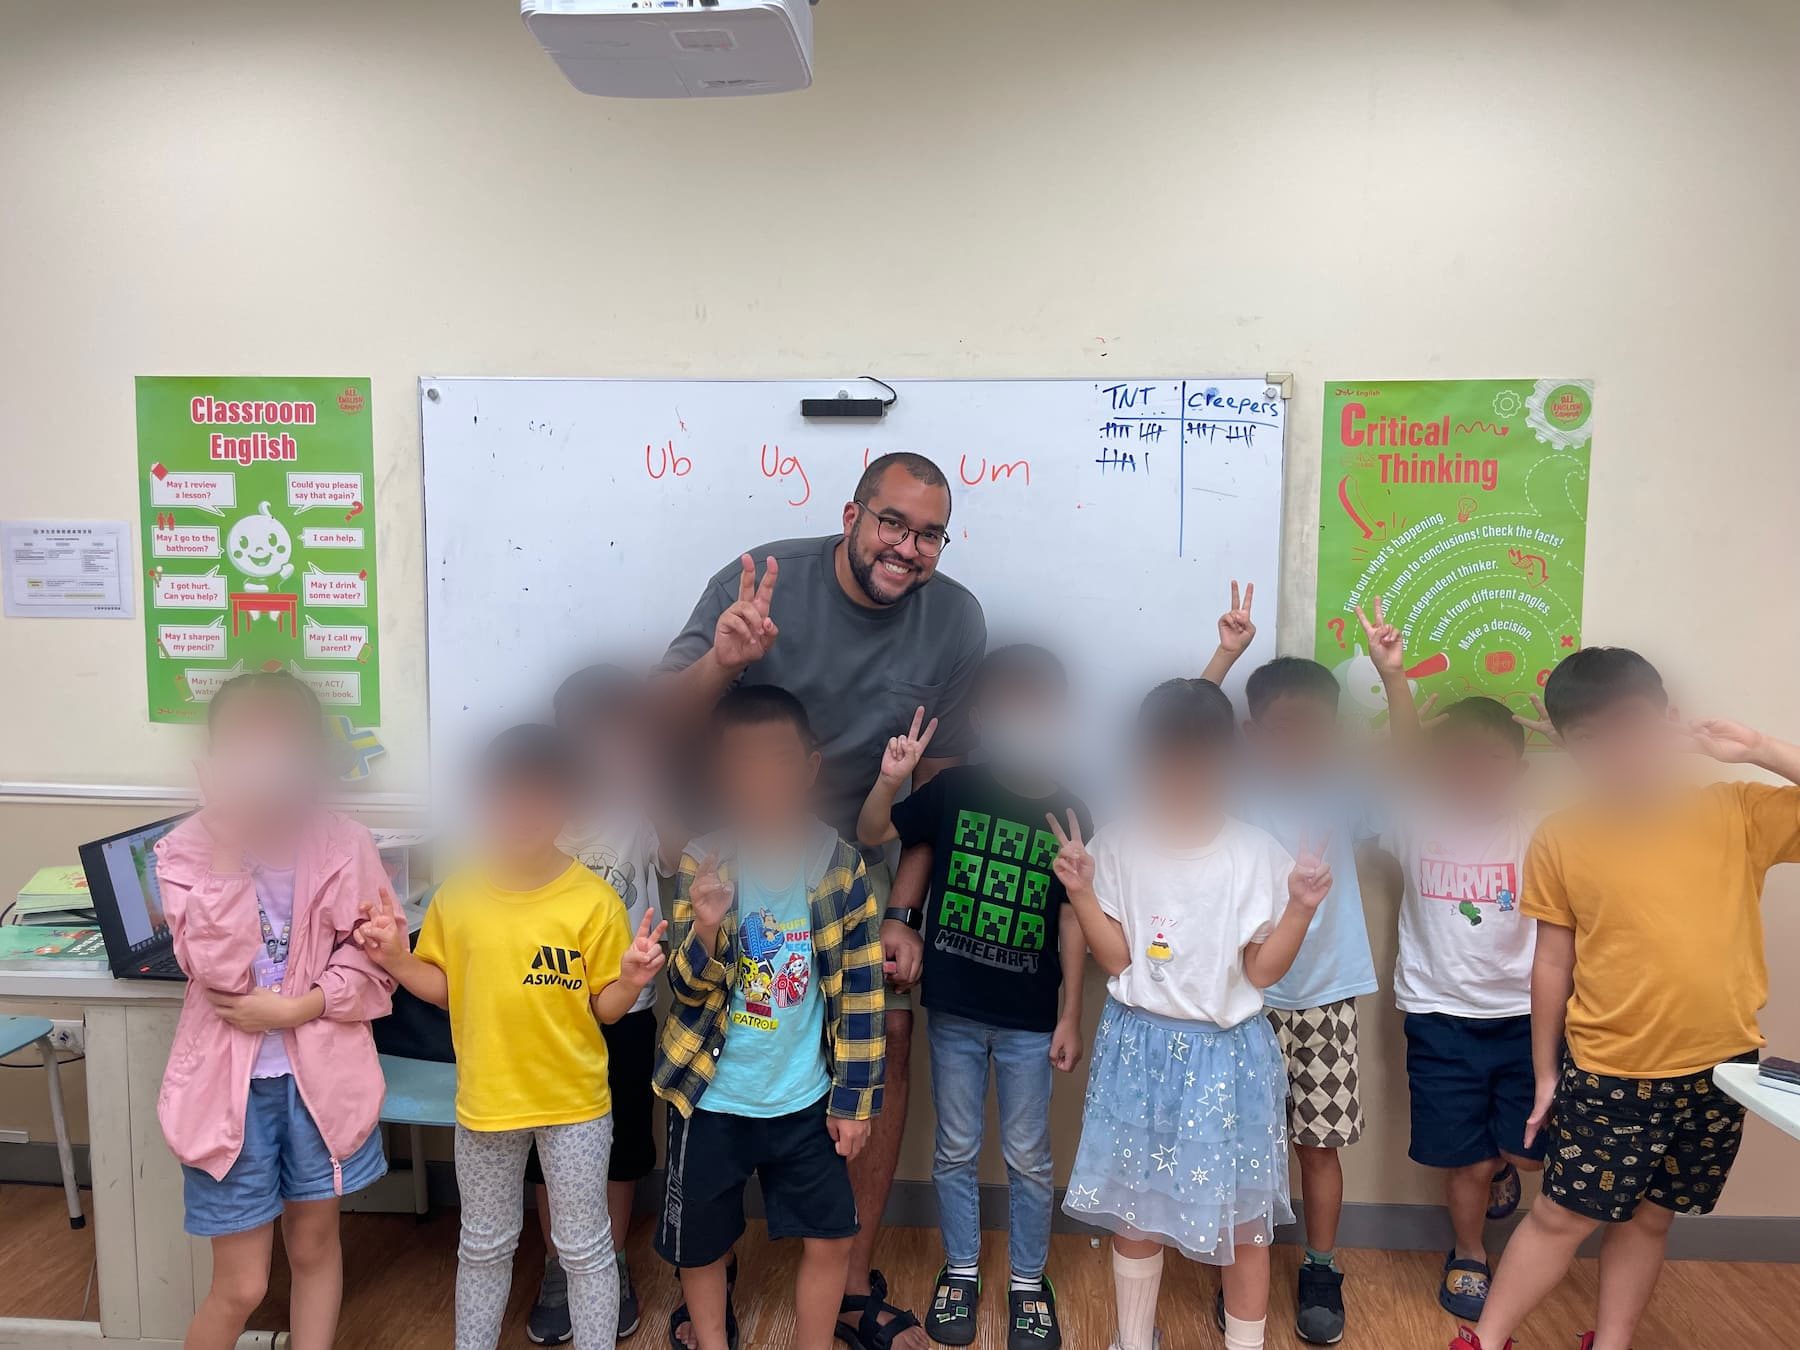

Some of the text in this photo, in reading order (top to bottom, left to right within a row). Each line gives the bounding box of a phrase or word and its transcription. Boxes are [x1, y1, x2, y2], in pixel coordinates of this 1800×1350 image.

[1103, 384, 1156, 410] TNT
[191, 396, 316, 424] Classroom
[1341, 402, 1450, 447] Critical
[210, 433, 296, 466] English
[646, 440, 692, 479] Ub
[761, 444, 810, 506] Ug
[960, 453, 1030, 487] Um
[1378, 453, 1498, 491] Thinking
[167, 481, 182, 490] May
[291, 481, 358, 491] Could you please
[182, 491, 211, 499] lesson?
[296, 493, 308, 501] say
[328, 491, 355, 501] again?
[156, 534, 172, 544] May
[180, 536, 190, 544] go
[336, 534, 356, 543] help.
[1344, 512, 1446, 612] Find out what's happening.
[1387, 570, 1412, 596] jump
[1408, 561, 1420, 572] to
[1418, 528, 1480, 564] conclusions!
[1482, 525, 1513, 538] Check
[1516, 526, 1533, 538] the
[1534, 529, 1564, 548] facts!
[1457, 560, 1498, 577] thinker.
[176, 583, 189, 592] got
[311, 582, 327, 590] May
[196, 593, 217, 602] help?
[1405, 570, 1458, 622] independent
[1429, 588, 1550, 643] Think from different angles.
[165, 633, 181, 642] May
[189, 633, 220, 642] sharpen
[309, 634, 326, 642] May
[1402, 624, 1413, 636] an
[1458, 619, 1532, 650] Make a decision.
[187, 643, 214, 652] pencil?
[321, 645, 351, 653] parent?
[192, 678, 208, 686] May
[786, 931, 809, 942] RUF
[934, 930, 1039, 974] MINECRAFT
[523, 974, 582, 990] ASWIND
[733, 1012, 778, 1031] PATROL
